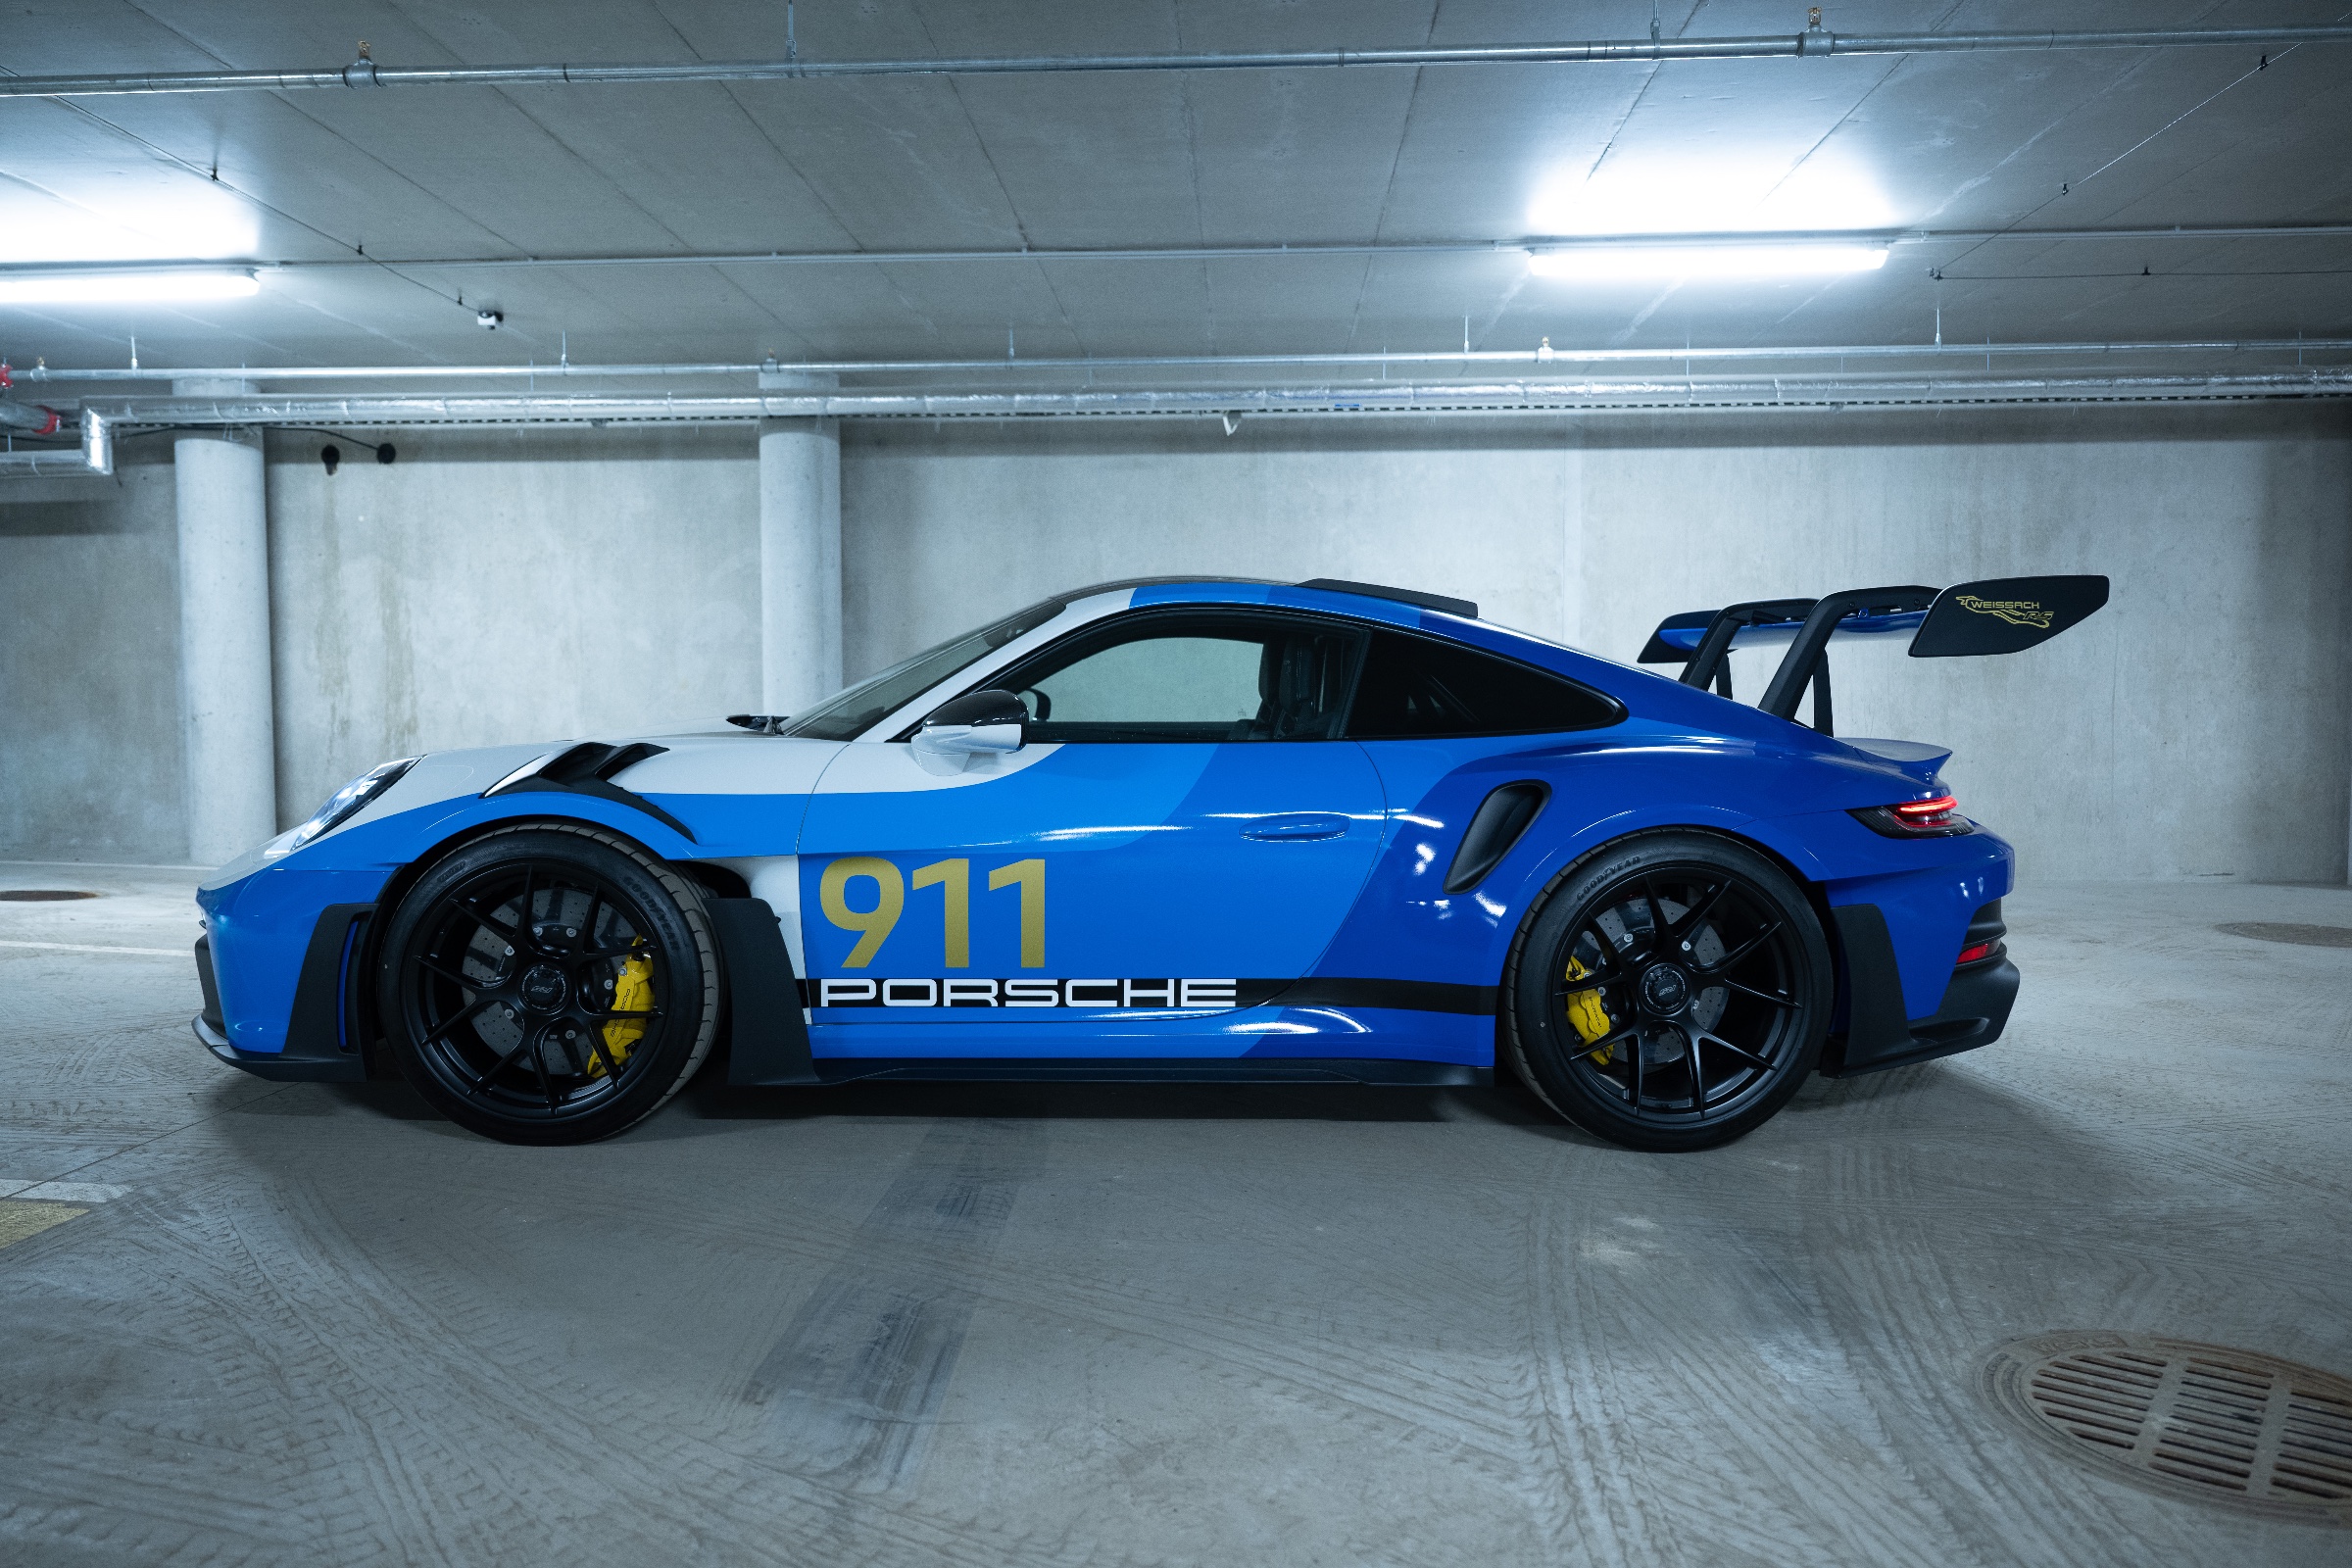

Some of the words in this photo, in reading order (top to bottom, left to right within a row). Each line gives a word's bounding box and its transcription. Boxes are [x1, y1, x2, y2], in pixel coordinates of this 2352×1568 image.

[1970, 601, 2040, 610] WEISSACH
[1577, 856, 1641, 901] GOODYEAR
[623, 876, 681, 951] GOODYEAR
[819, 856, 1046, 968] 911
[819, 978, 1237, 1007] PORSCHE
